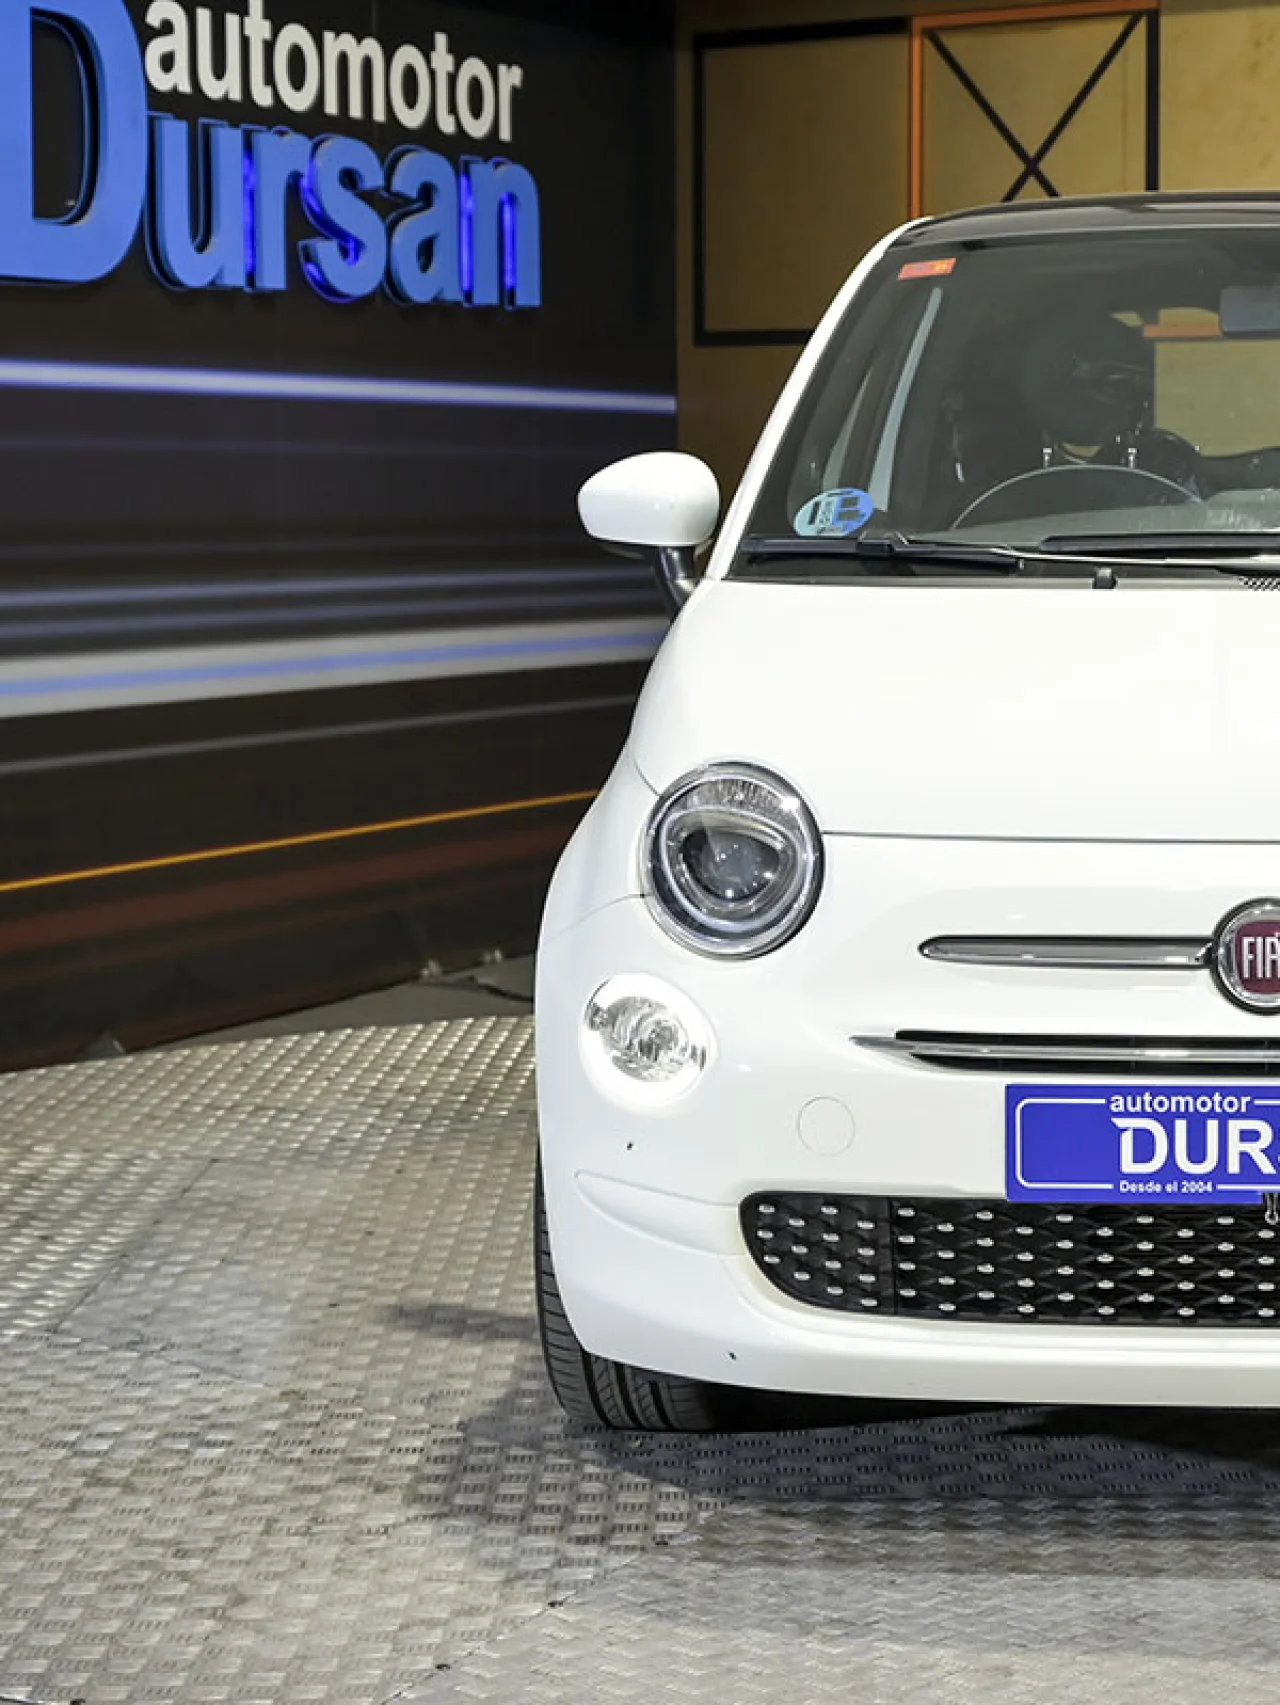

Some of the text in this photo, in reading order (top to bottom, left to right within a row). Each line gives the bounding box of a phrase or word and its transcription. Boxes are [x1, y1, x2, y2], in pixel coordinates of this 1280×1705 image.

[144, 0, 524, 142] automotor
[0, 0, 541, 309] Dursan
[1110, 1092, 1251, 1113] automotor
[1119, 1180, 1162, 1194] Desde
[1181, 1180, 1213, 1194] 2004
